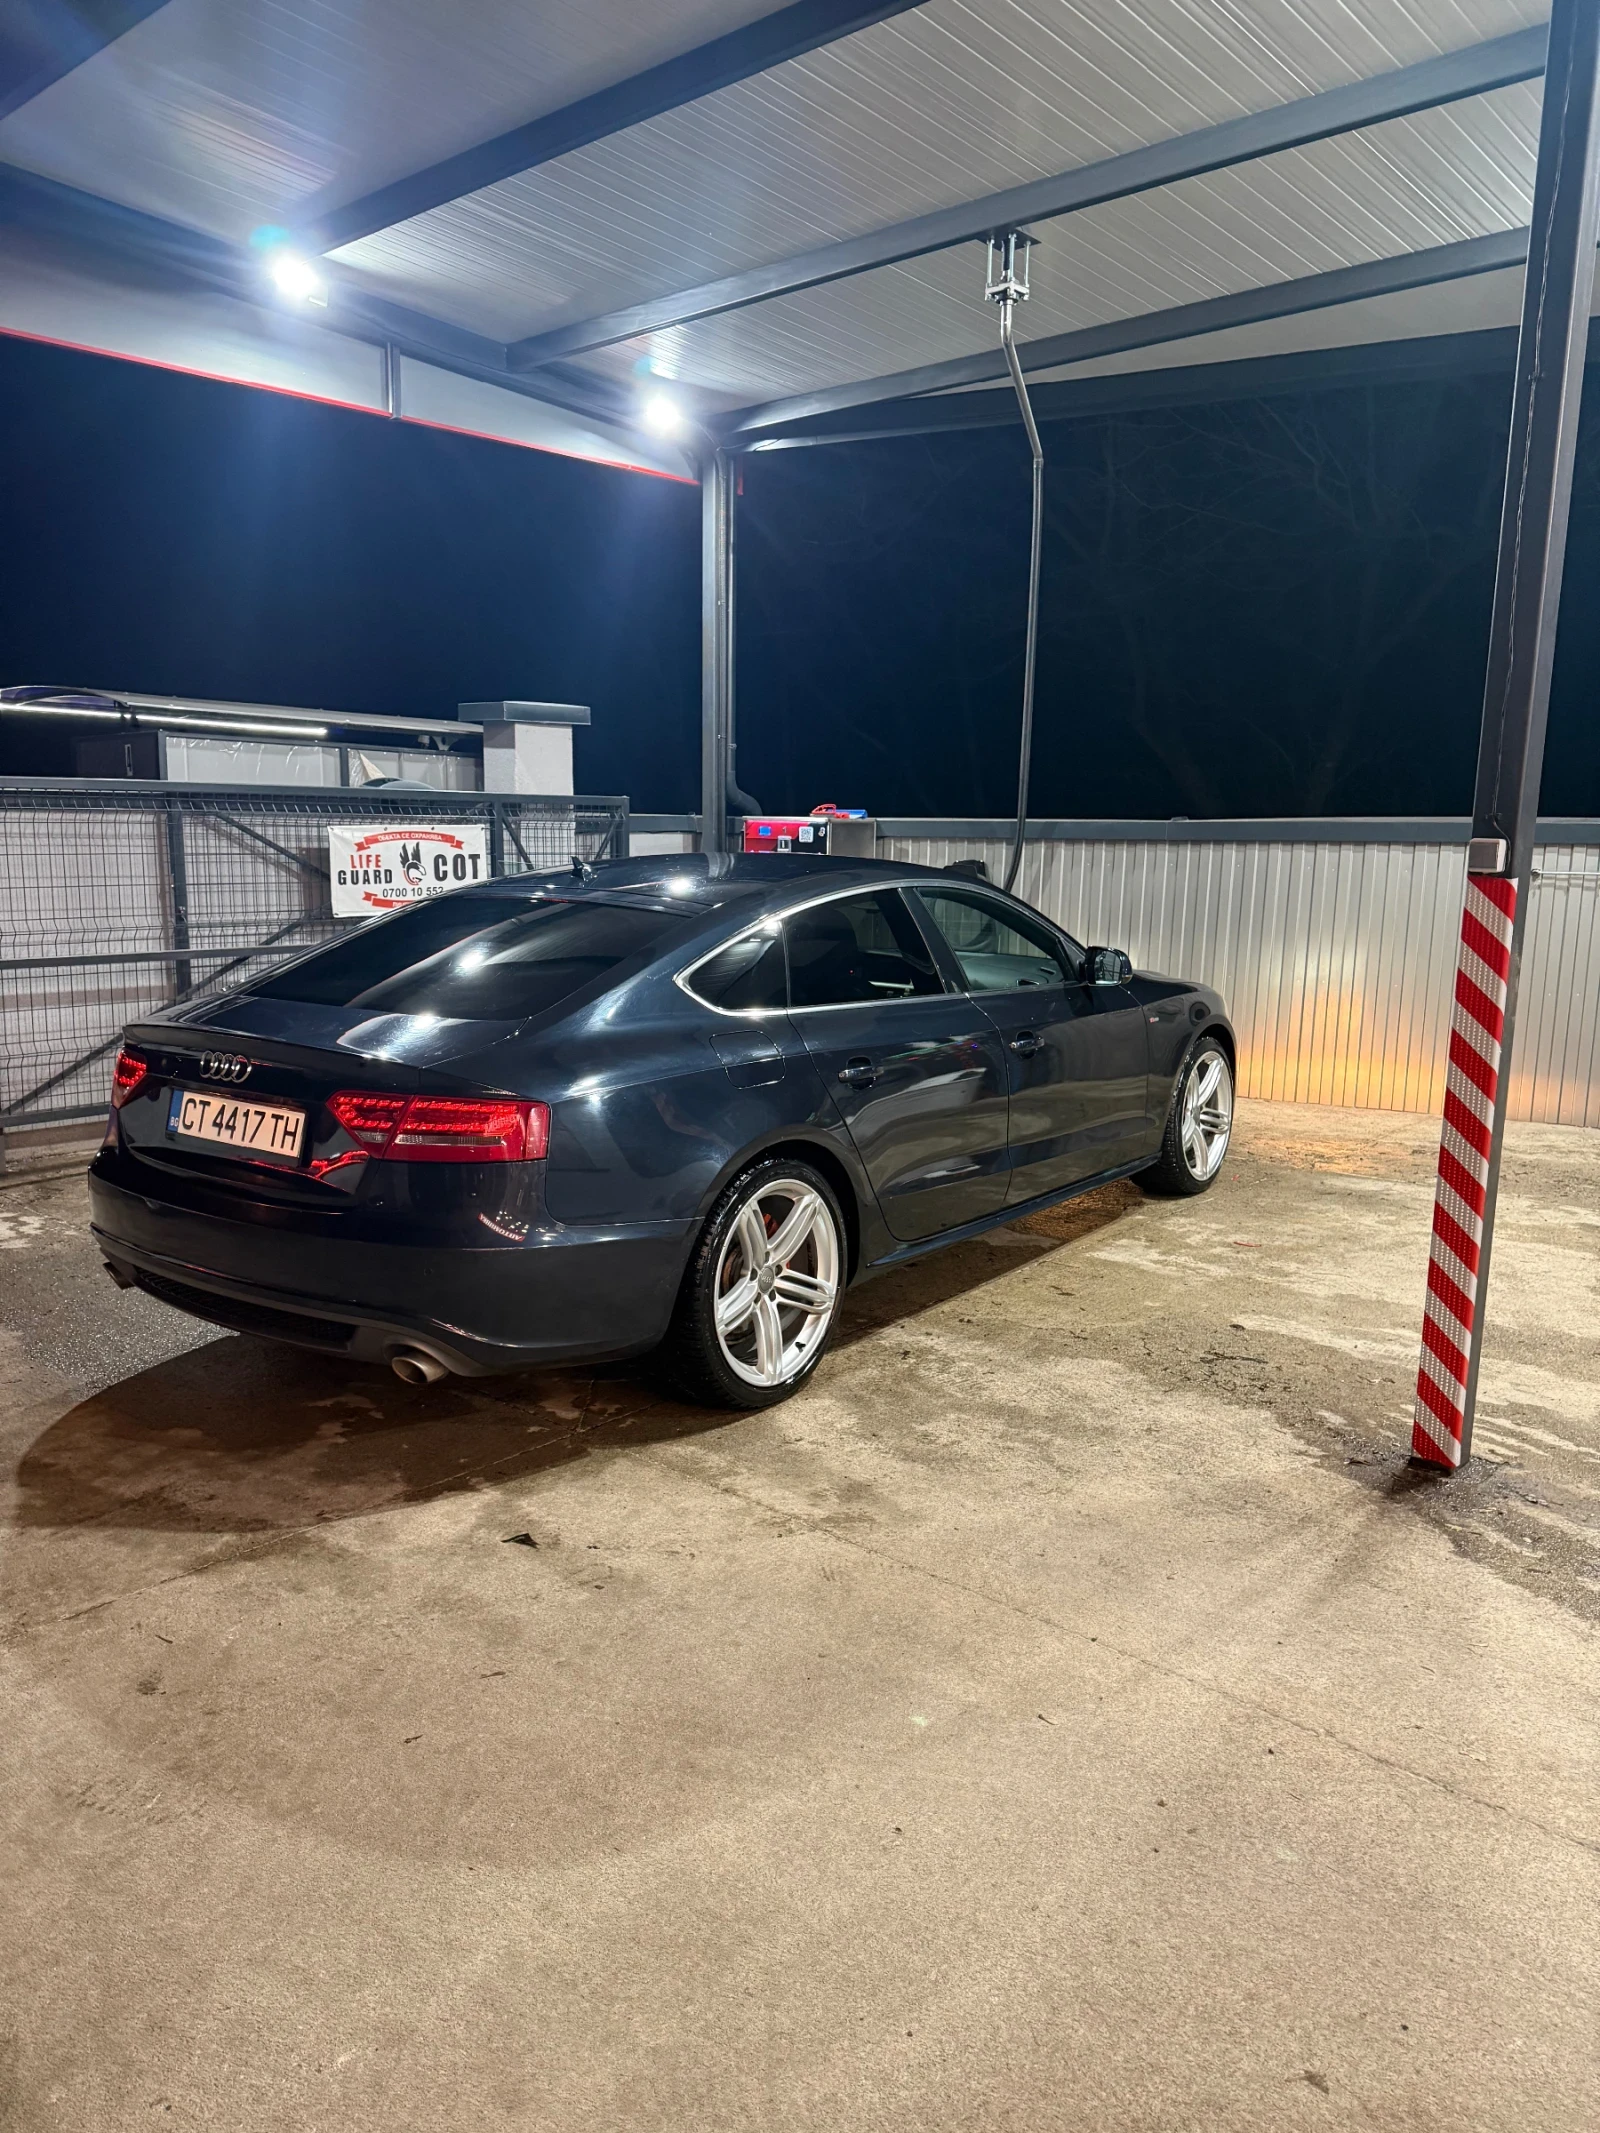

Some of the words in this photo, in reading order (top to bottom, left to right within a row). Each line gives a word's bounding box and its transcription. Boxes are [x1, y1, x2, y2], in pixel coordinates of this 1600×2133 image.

[350, 854, 382, 869] LIFE
[337, 869, 393, 886] GUARD
[382, 887, 407, 898] 0700
[410, 887, 423, 897] 10
[169, 1116, 179, 1127] BG
[182, 1097, 211, 1133] CT
[212, 1103, 266, 1143] 4417
[270, 1113, 300, 1151] TH
